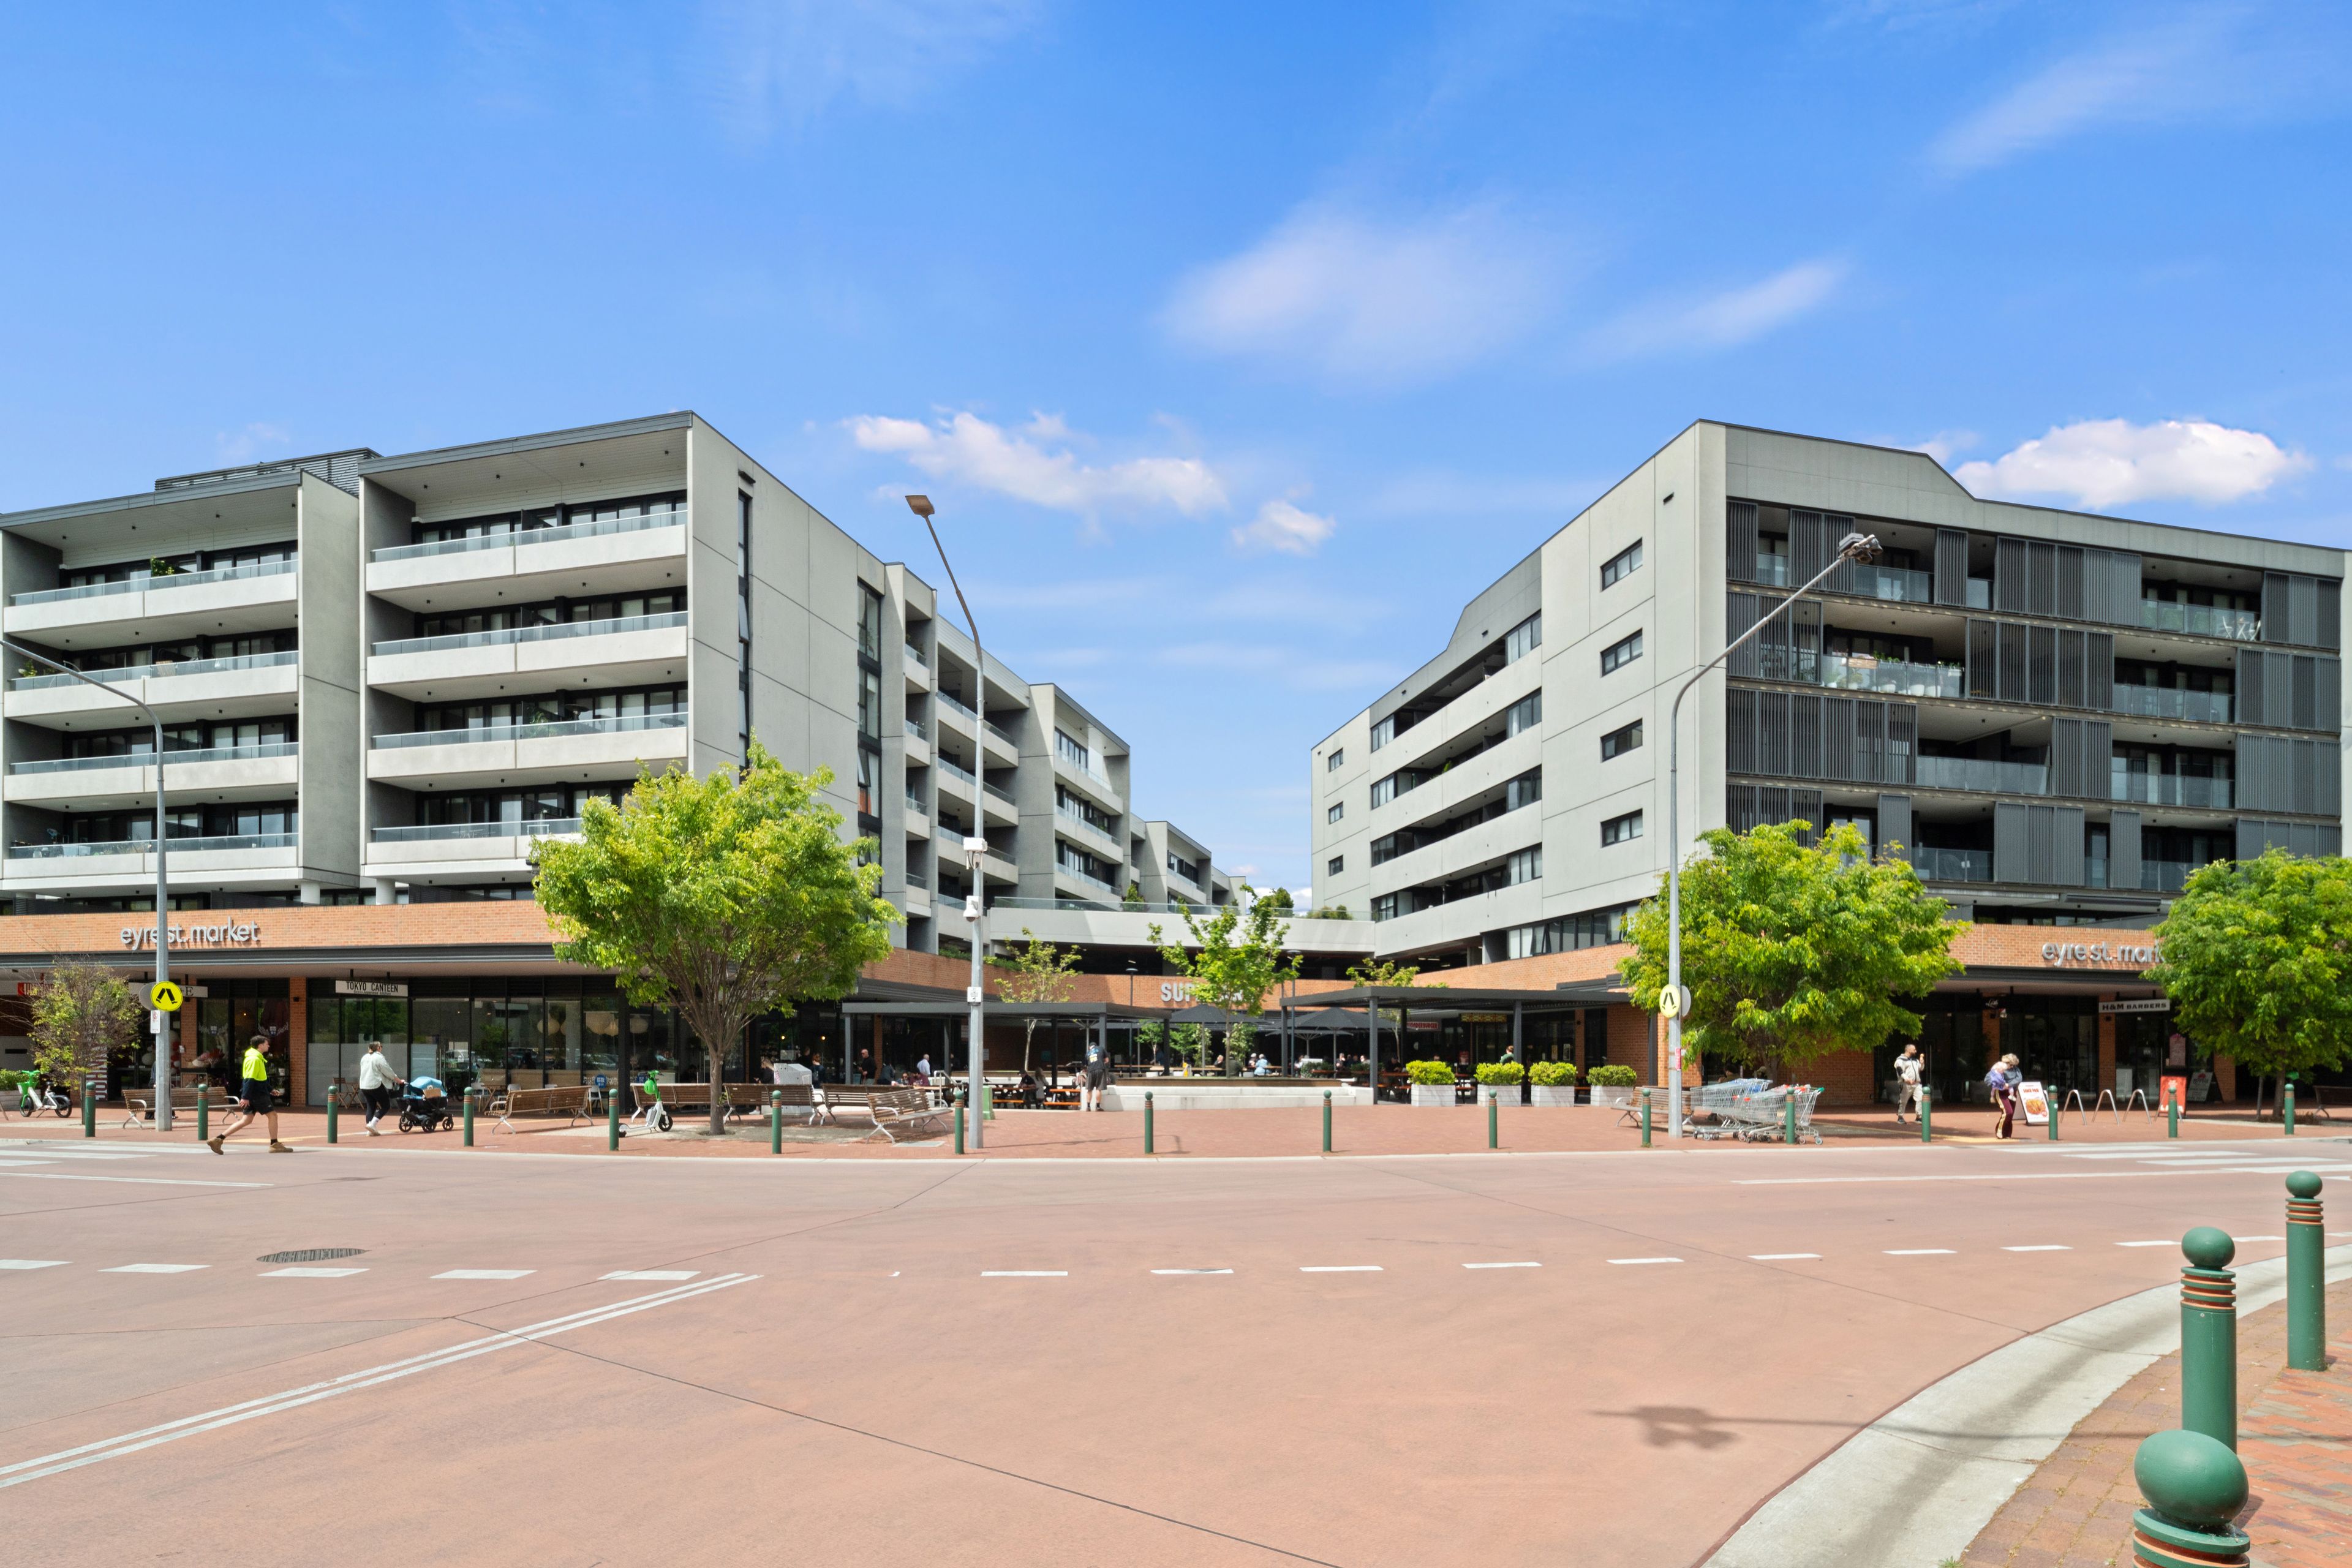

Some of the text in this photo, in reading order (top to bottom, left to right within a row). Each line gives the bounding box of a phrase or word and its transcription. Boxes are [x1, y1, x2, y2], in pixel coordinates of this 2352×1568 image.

[190, 916, 258, 942] market
[2041, 939, 2165, 967] eyre st. mark
[346, 981, 367, 990] TOKYO
[371, 982, 398, 993] CANTEEN
